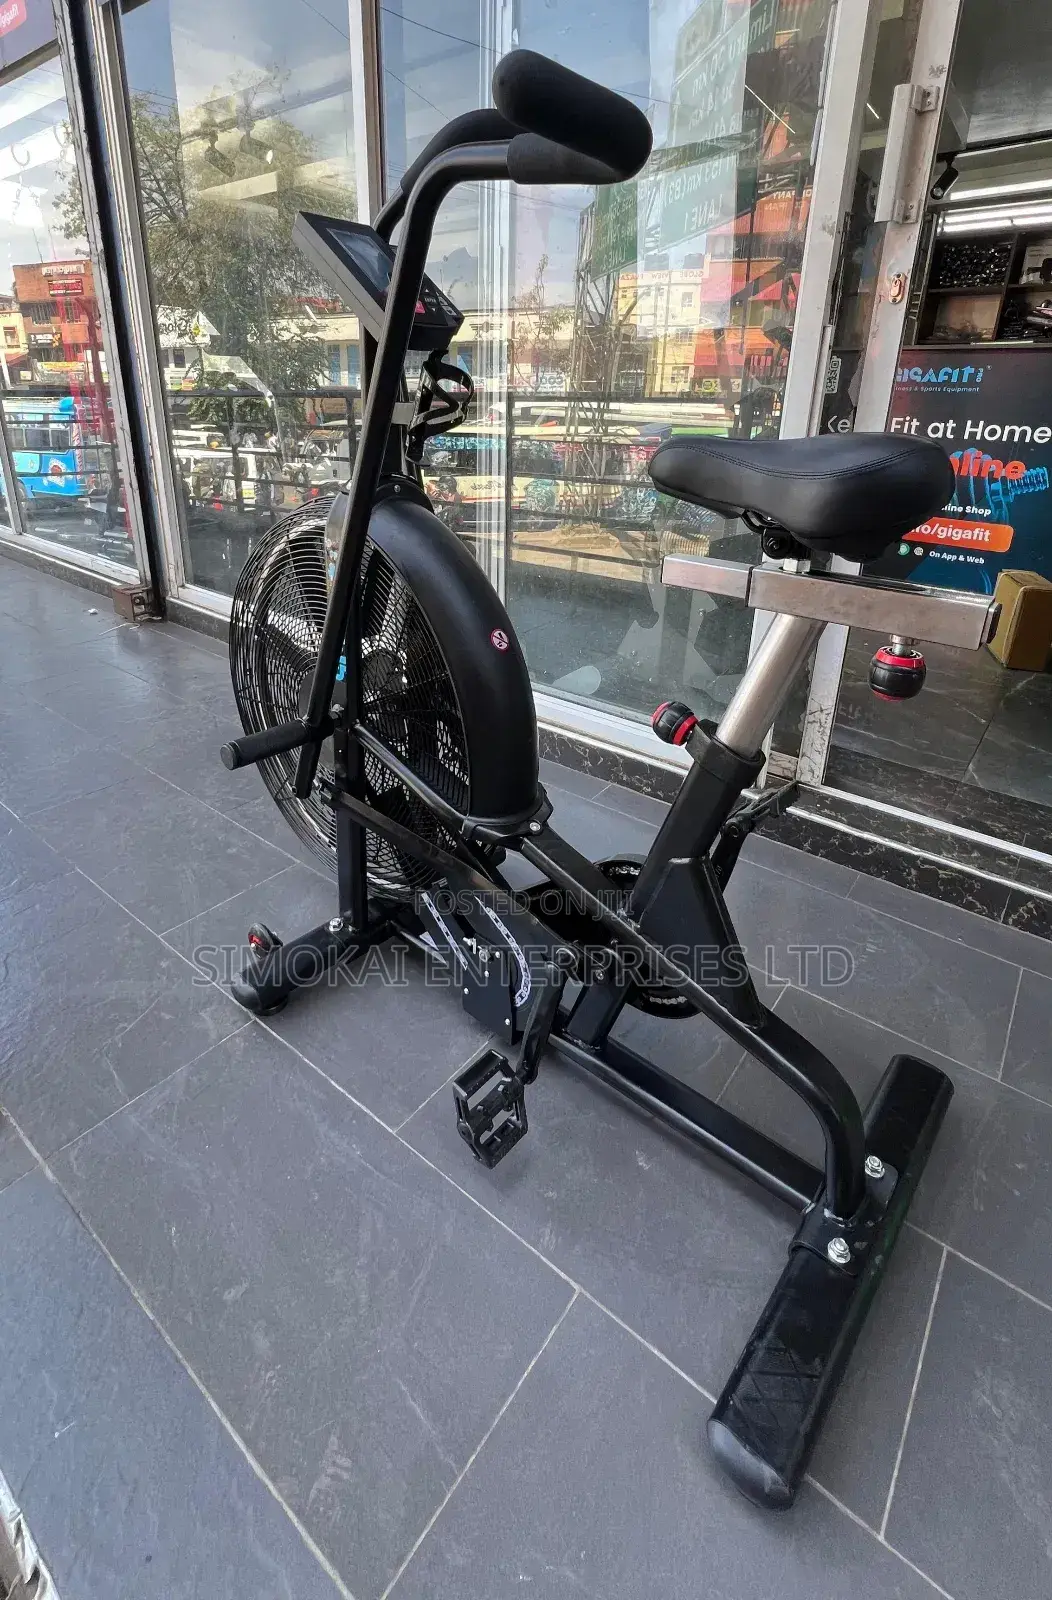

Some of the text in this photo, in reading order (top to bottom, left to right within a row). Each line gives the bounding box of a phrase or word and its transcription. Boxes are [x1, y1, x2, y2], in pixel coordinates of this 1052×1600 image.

[920, 386, 941, 394] Sports
[943, 386, 980, 395] Equipment
[890, 416, 920, 436] Fit
[927, 419, 957, 439] at
[963, 420, 1052, 444] Home
[950, 451, 1026, 480] line
[941, 503, 991, 517] line Shop
[929, 550, 985, 565] On App & Web
